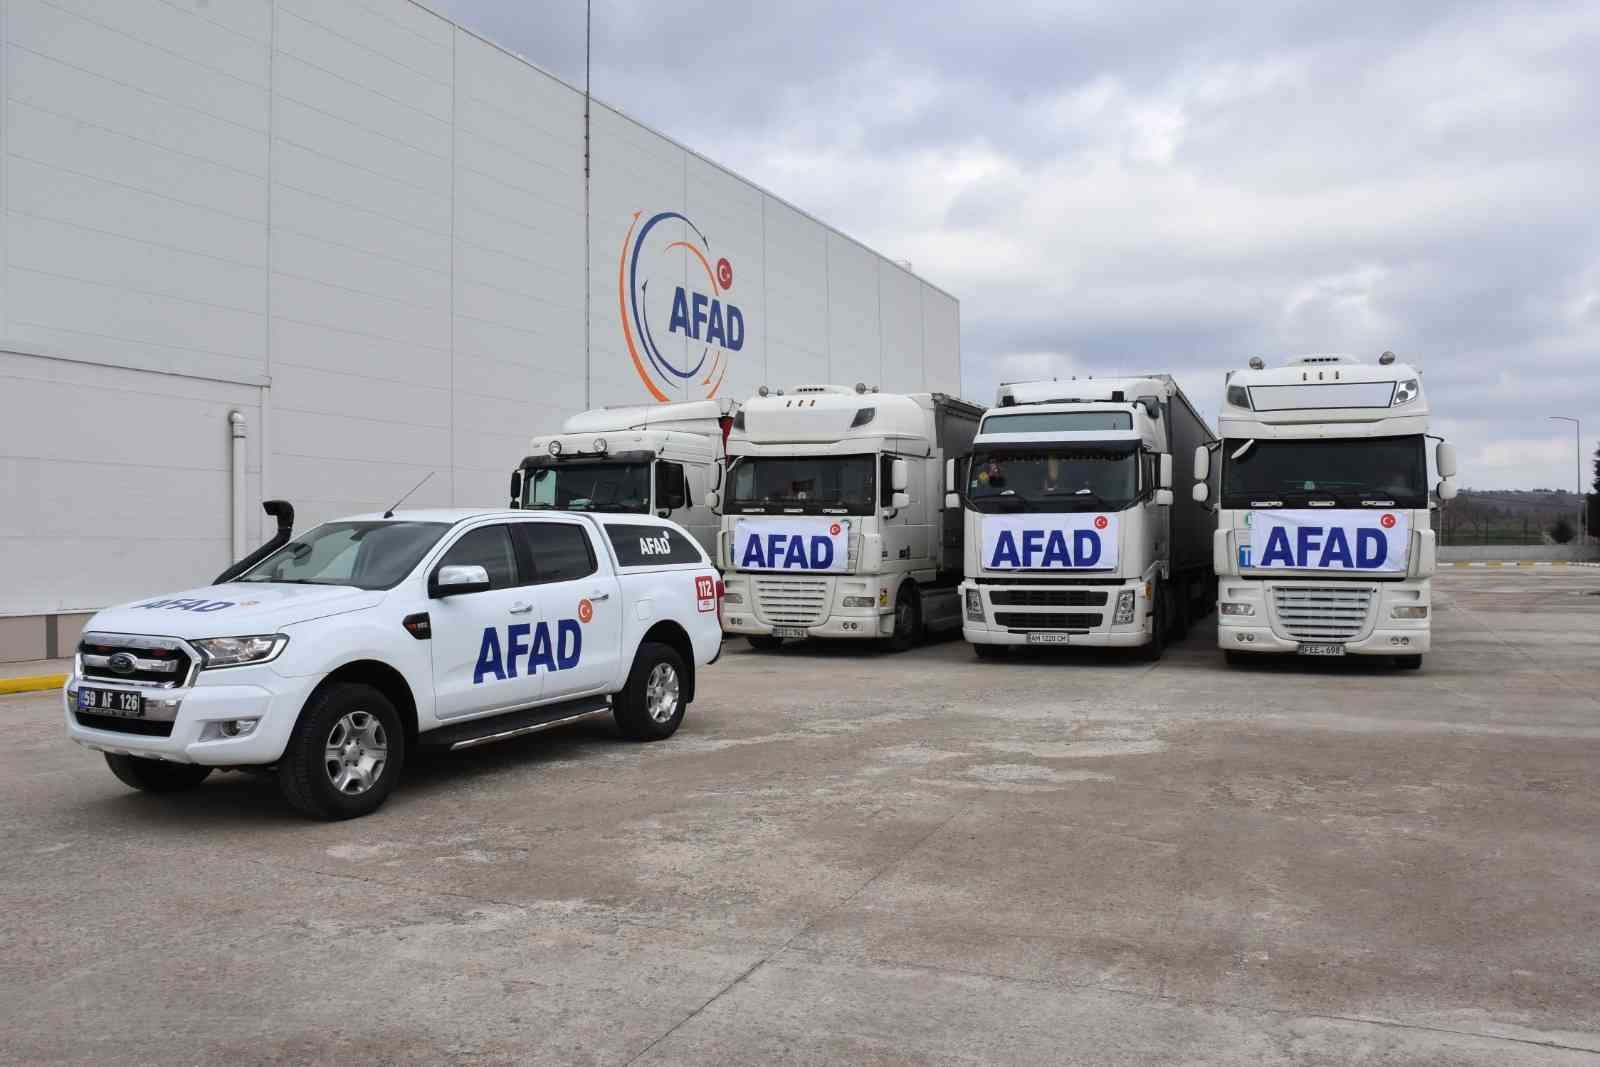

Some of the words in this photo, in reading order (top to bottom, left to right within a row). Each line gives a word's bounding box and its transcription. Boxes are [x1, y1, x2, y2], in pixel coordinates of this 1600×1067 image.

[669, 286, 745, 352] AFAD
[640, 537, 671, 555] AFAD
[741, 533, 834, 570] AFAD
[991, 529, 1102, 568] AFAD
[1260, 526, 1388, 568] AFAD
[131, 598, 236, 613] AFAD
[698, 580, 713, 598] 112
[473, 618, 583, 684] AFAD
[84, 690, 96, 706] 59
[101, 691, 113, 707] AF
[120, 693, 138, 711] 126
